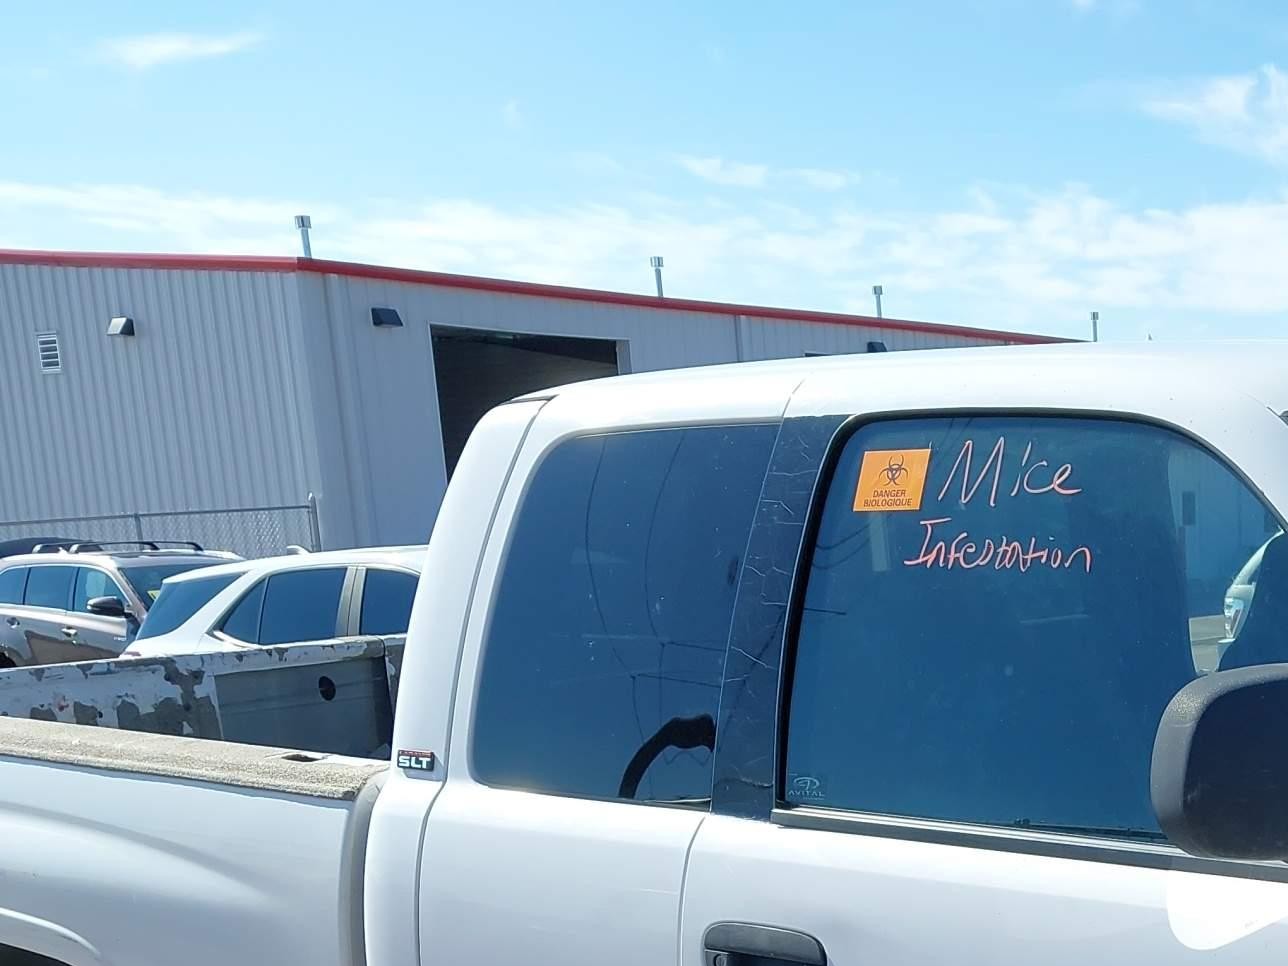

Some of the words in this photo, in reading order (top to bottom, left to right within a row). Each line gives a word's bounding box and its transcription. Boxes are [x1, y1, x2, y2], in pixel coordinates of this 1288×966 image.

[938, 436, 1082, 507] Mice
[873, 490, 906, 498] DANGER
[863, 498, 912, 507] BIOLOGIQUE
[903, 517, 1092, 573] Infestation
[398, 755, 430, 769] SLT
